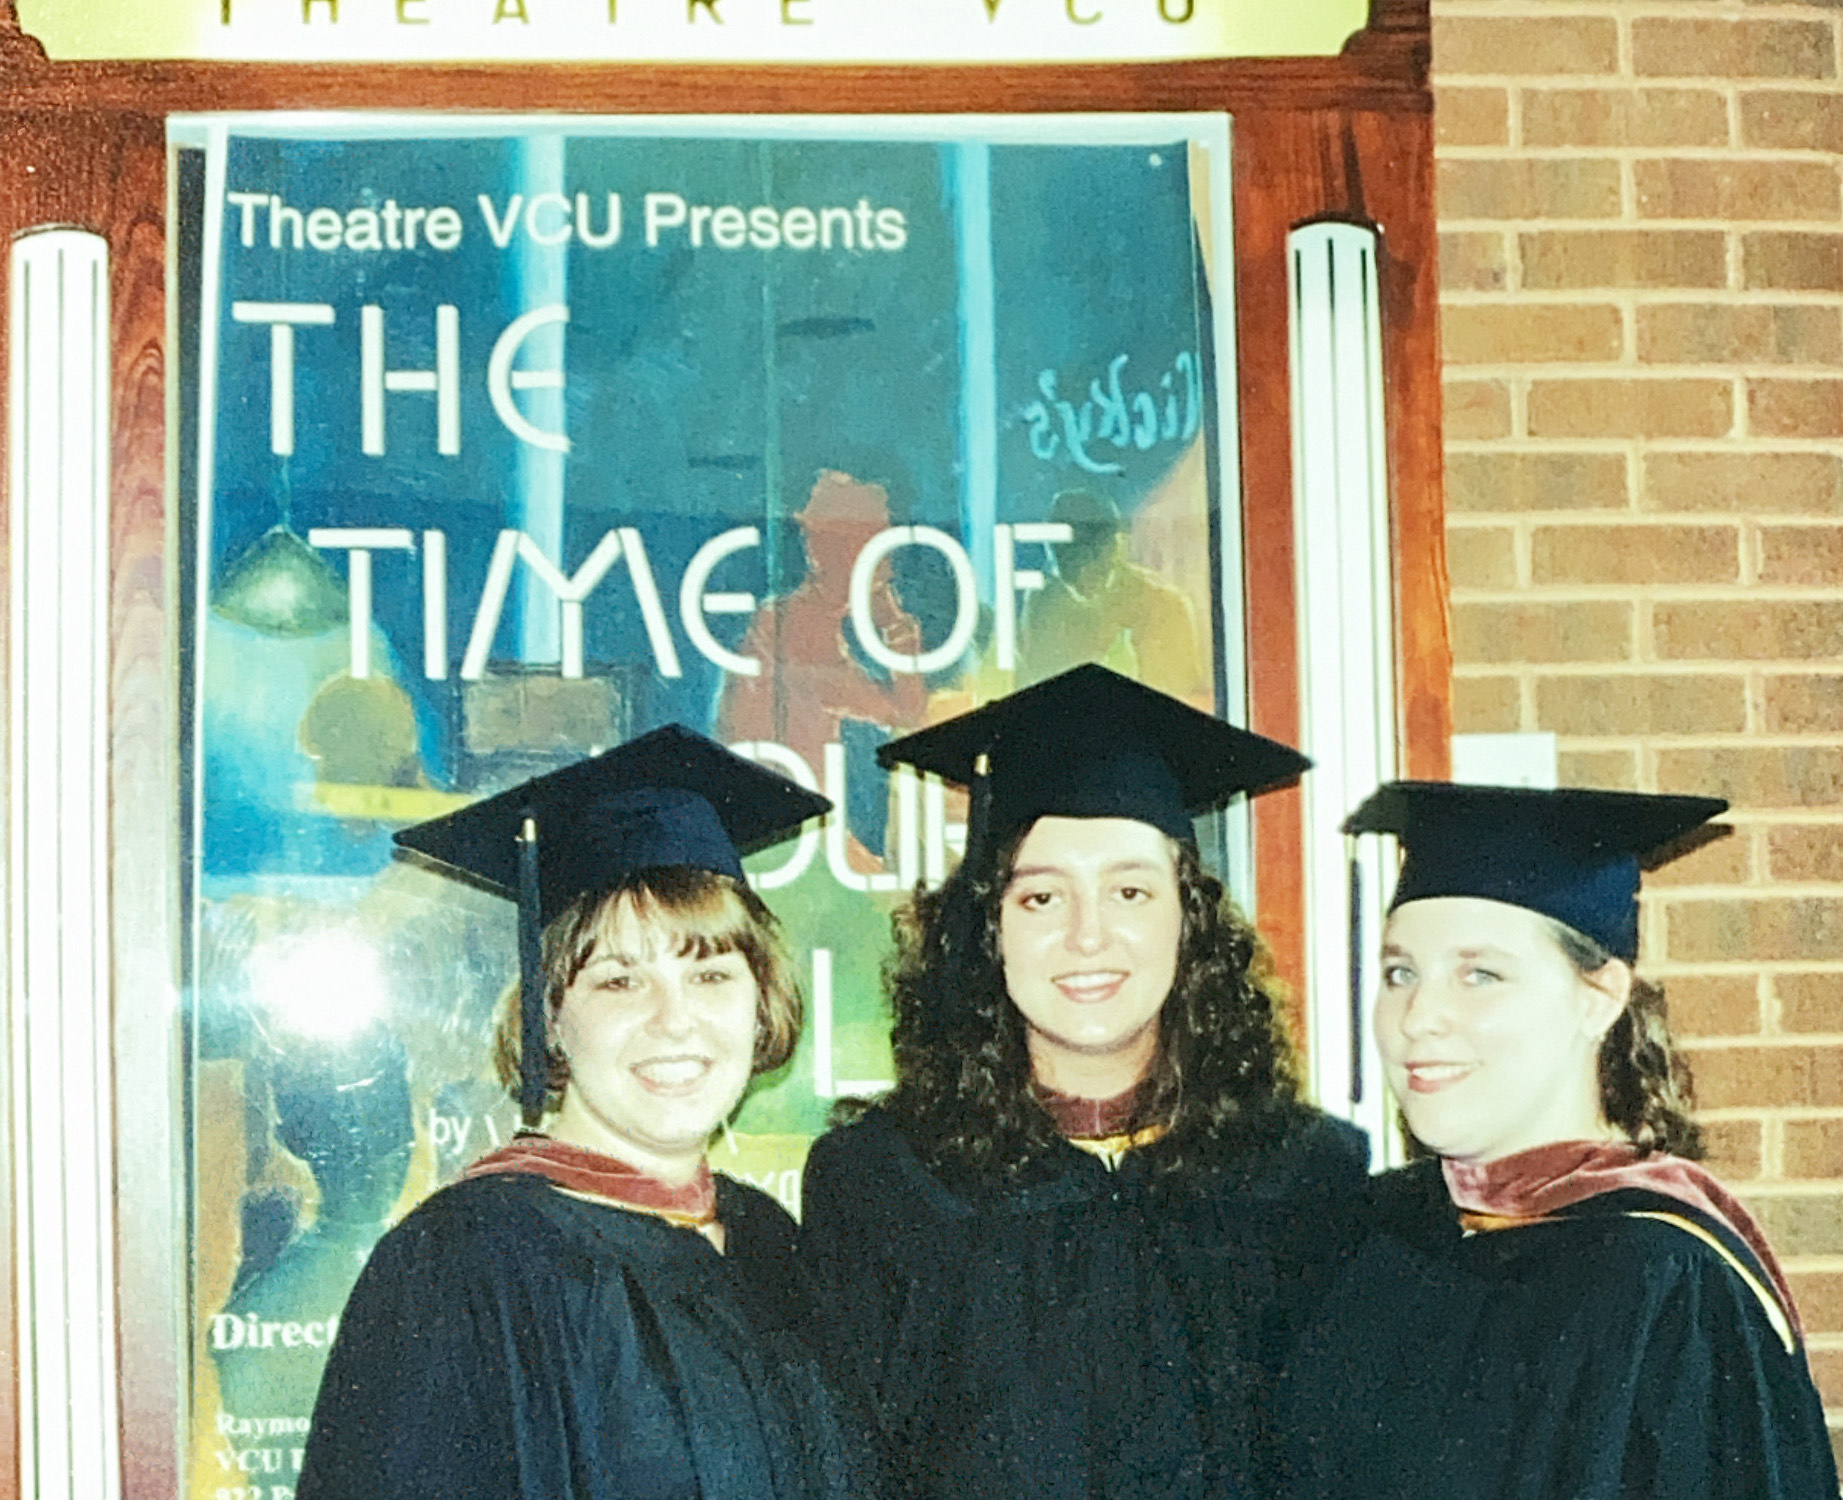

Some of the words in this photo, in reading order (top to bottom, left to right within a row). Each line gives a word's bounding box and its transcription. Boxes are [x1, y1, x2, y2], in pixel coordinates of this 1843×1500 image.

[227, 192, 462, 250] Theatre
[477, 192, 621, 248] VCU
[644, 192, 908, 250] Presents
[232, 301, 571, 456] THE
[308, 526, 761, 680] TIME
[849, 522, 1073, 675] OF
[429, 1108, 471, 1155] by
[215, 1448, 283, 1474] VCU
